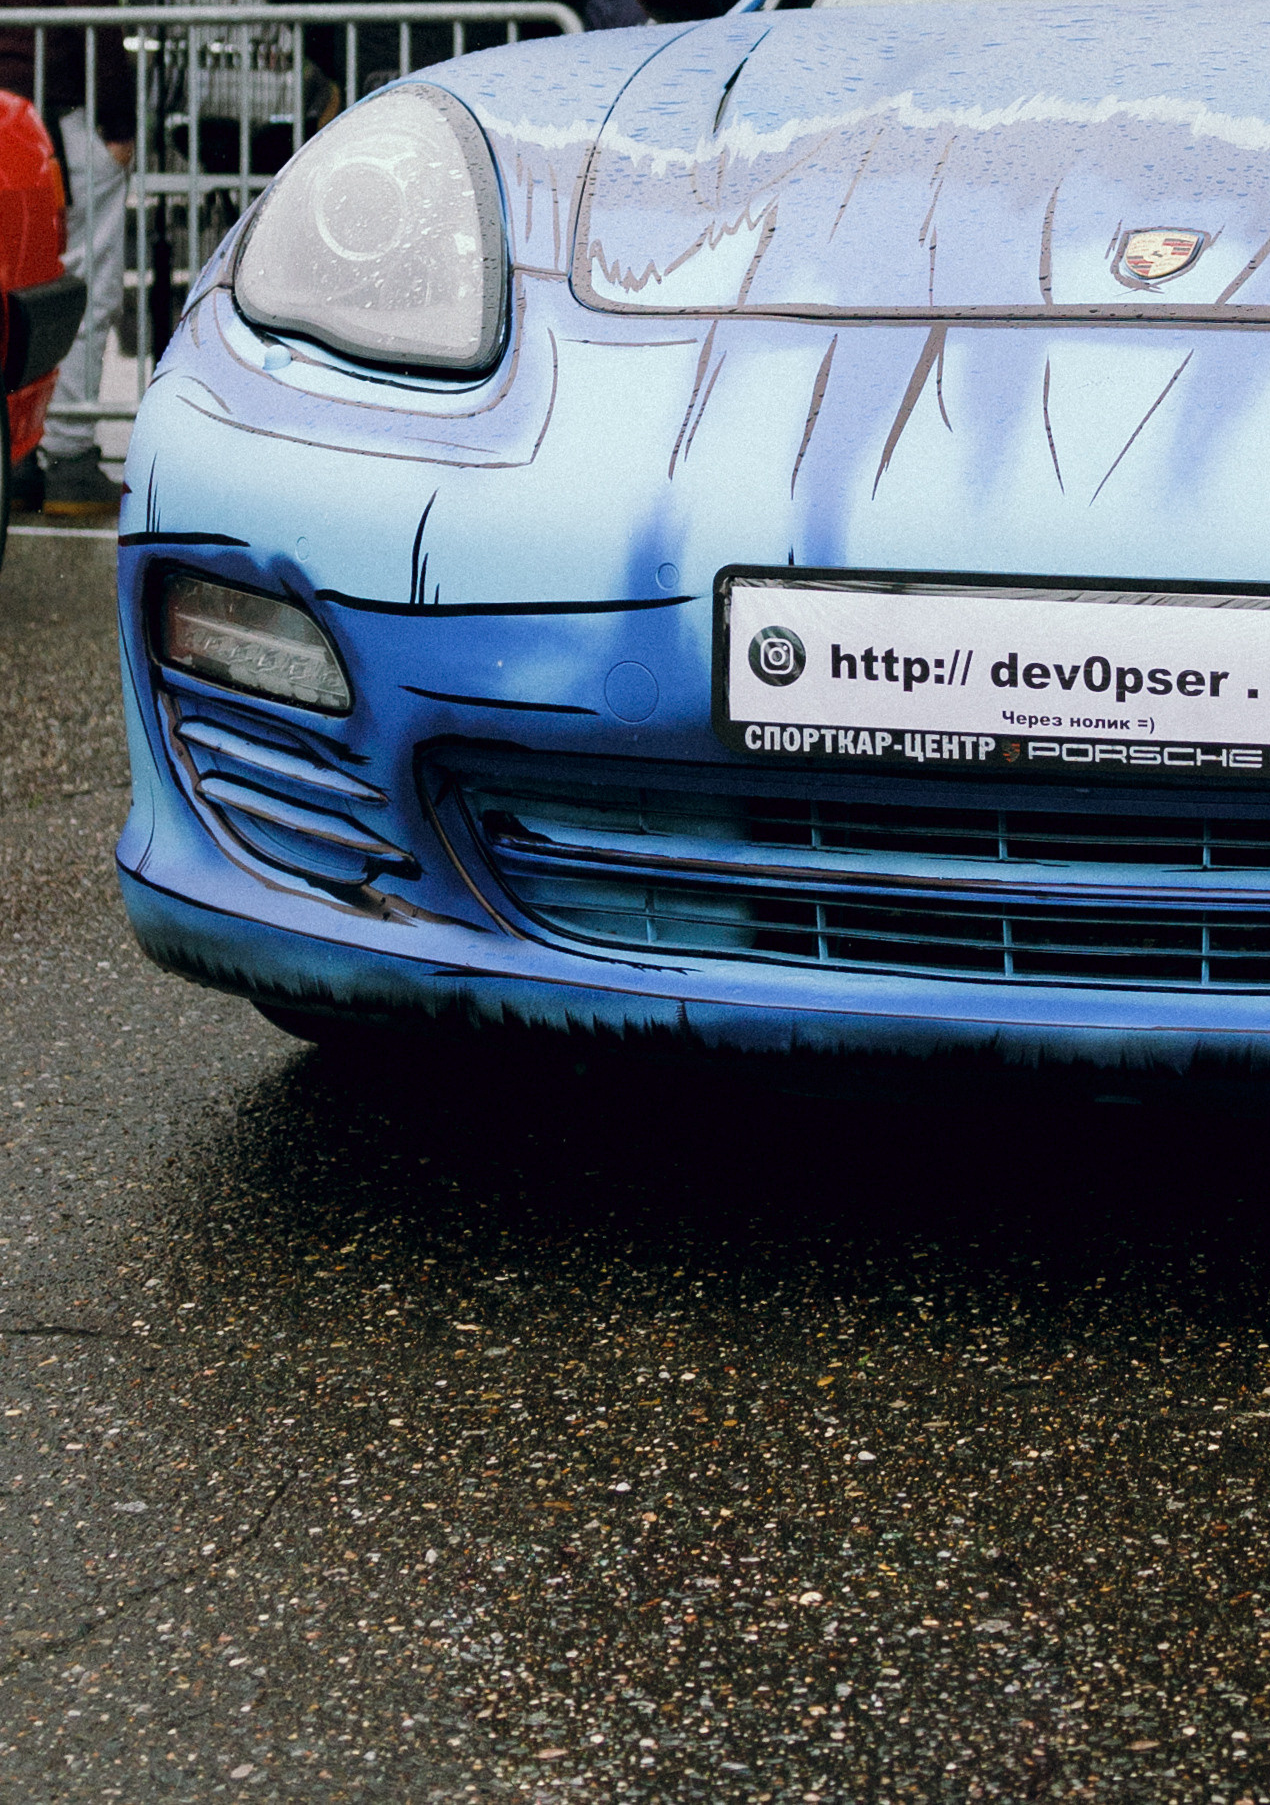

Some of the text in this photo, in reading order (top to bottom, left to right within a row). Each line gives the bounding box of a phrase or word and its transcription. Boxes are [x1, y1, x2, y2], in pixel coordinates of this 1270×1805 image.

[830, 643, 974, 692] http://
[990, 651, 1230, 703] dev0pser
[1002, 710, 1063, 728] Через
[1069, 714, 1131, 731] нолик
[744, 724, 996, 763] СПОРТКАР-ЦЕНТР
[1027, 741, 1263, 769] PORSCHE
